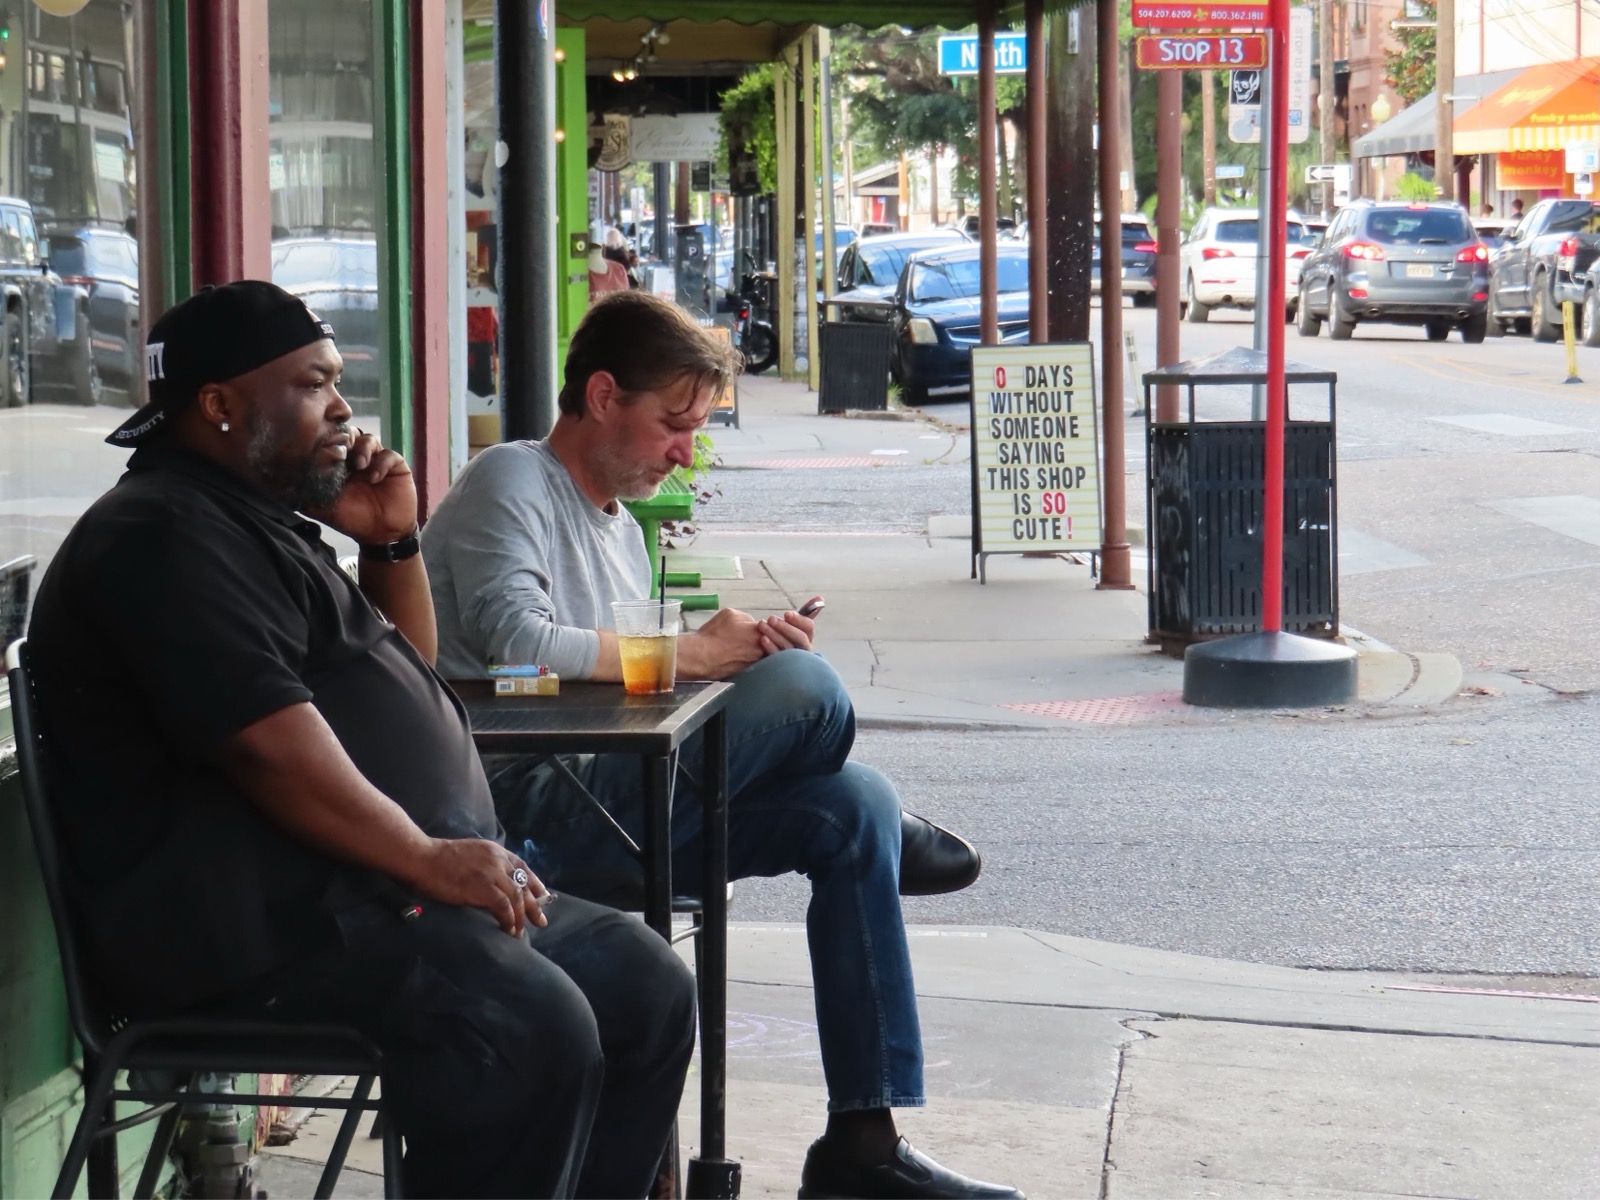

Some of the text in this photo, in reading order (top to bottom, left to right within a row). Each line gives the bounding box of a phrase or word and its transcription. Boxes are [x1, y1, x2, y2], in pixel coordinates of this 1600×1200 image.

[961, 41, 1022, 68] Nth
[1159, 38, 1245, 63] STOP 13
[1503, 164, 1559, 178] monkey
[1025, 365, 1074, 389] DAYS
[990, 390, 1074, 414] WITHOUT
[115, 410, 165, 439] SECURITY
[991, 415, 1080, 439] SOMEONE
[999, 441, 1065, 465] SAYING
[987, 466, 1086, 490] THIS SHOP
[1013, 492, 1066, 515] IS SO
